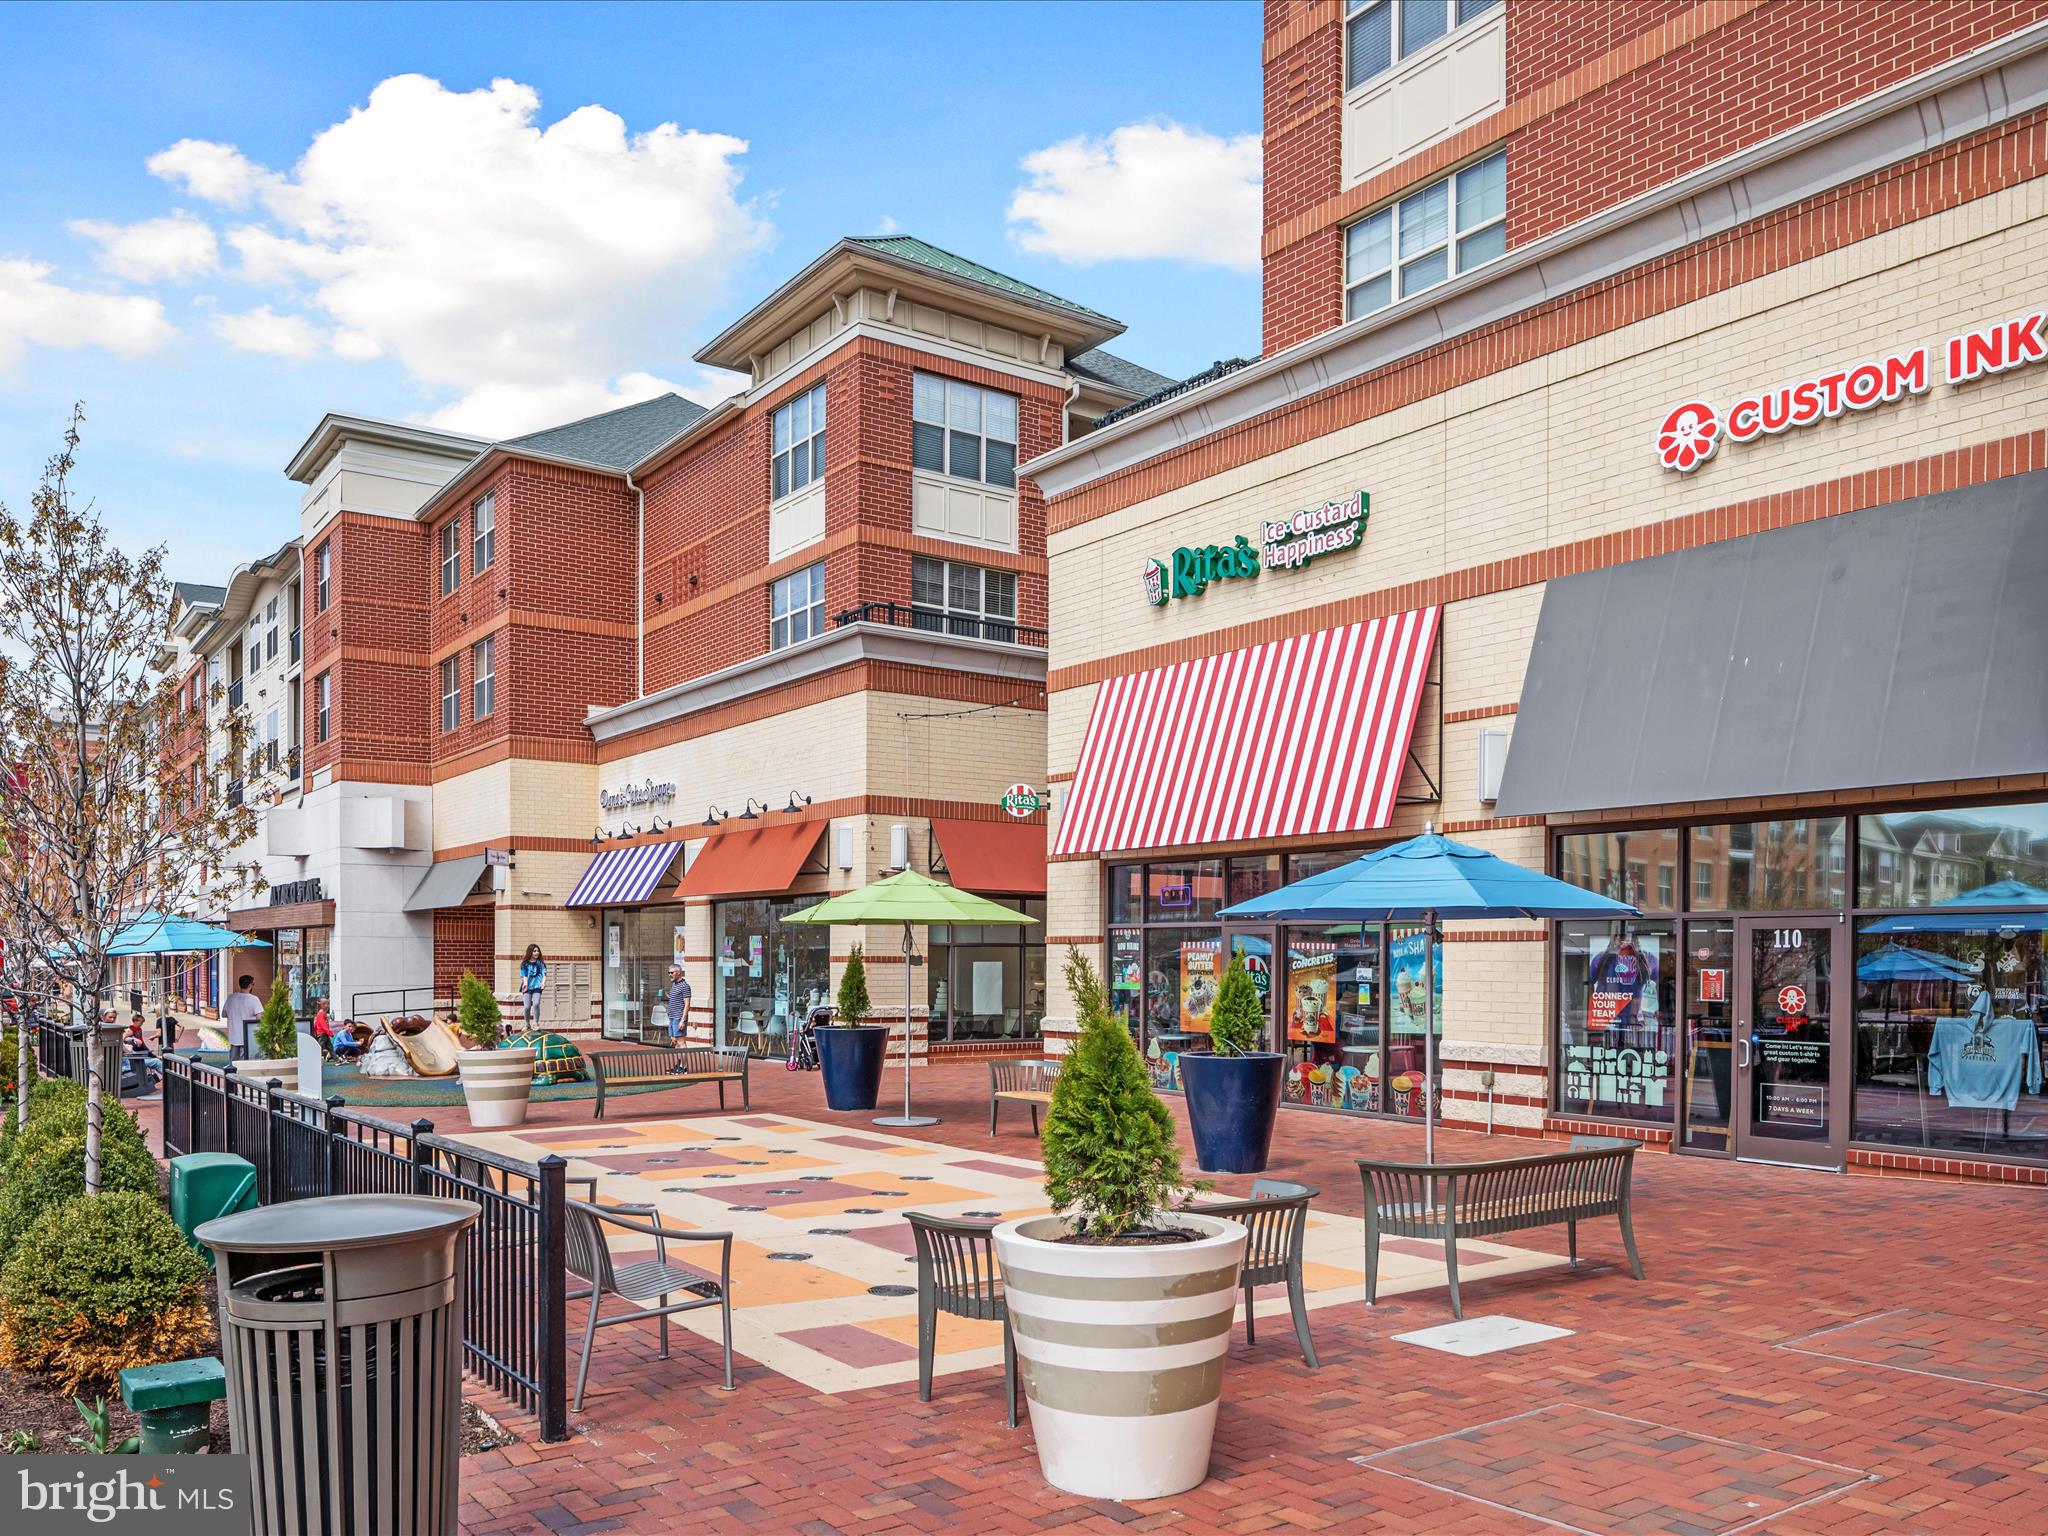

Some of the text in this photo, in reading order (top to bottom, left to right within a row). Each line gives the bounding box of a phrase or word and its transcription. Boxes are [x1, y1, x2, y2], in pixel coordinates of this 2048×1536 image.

[1729, 314, 2045, 438] CUSTOM INK
[1263, 525, 1354, 569] Happiness
[1172, 535, 1258, 598] Rita's
[1006, 793, 1036, 807] Rita's
[1773, 929, 1802, 948] 110
[1187, 952, 1214, 961] PEANUT
[1292, 953, 1334, 970] CONCRETES
[1187, 961, 1214, 970] BUTTER
[1592, 992, 1634, 1000] CONNECT
[1592, 1000, 1616, 1008] YOUR
[1592, 1010, 1616, 1018] TEAM
[1776, 1015, 1808, 1025] CUSTOM
